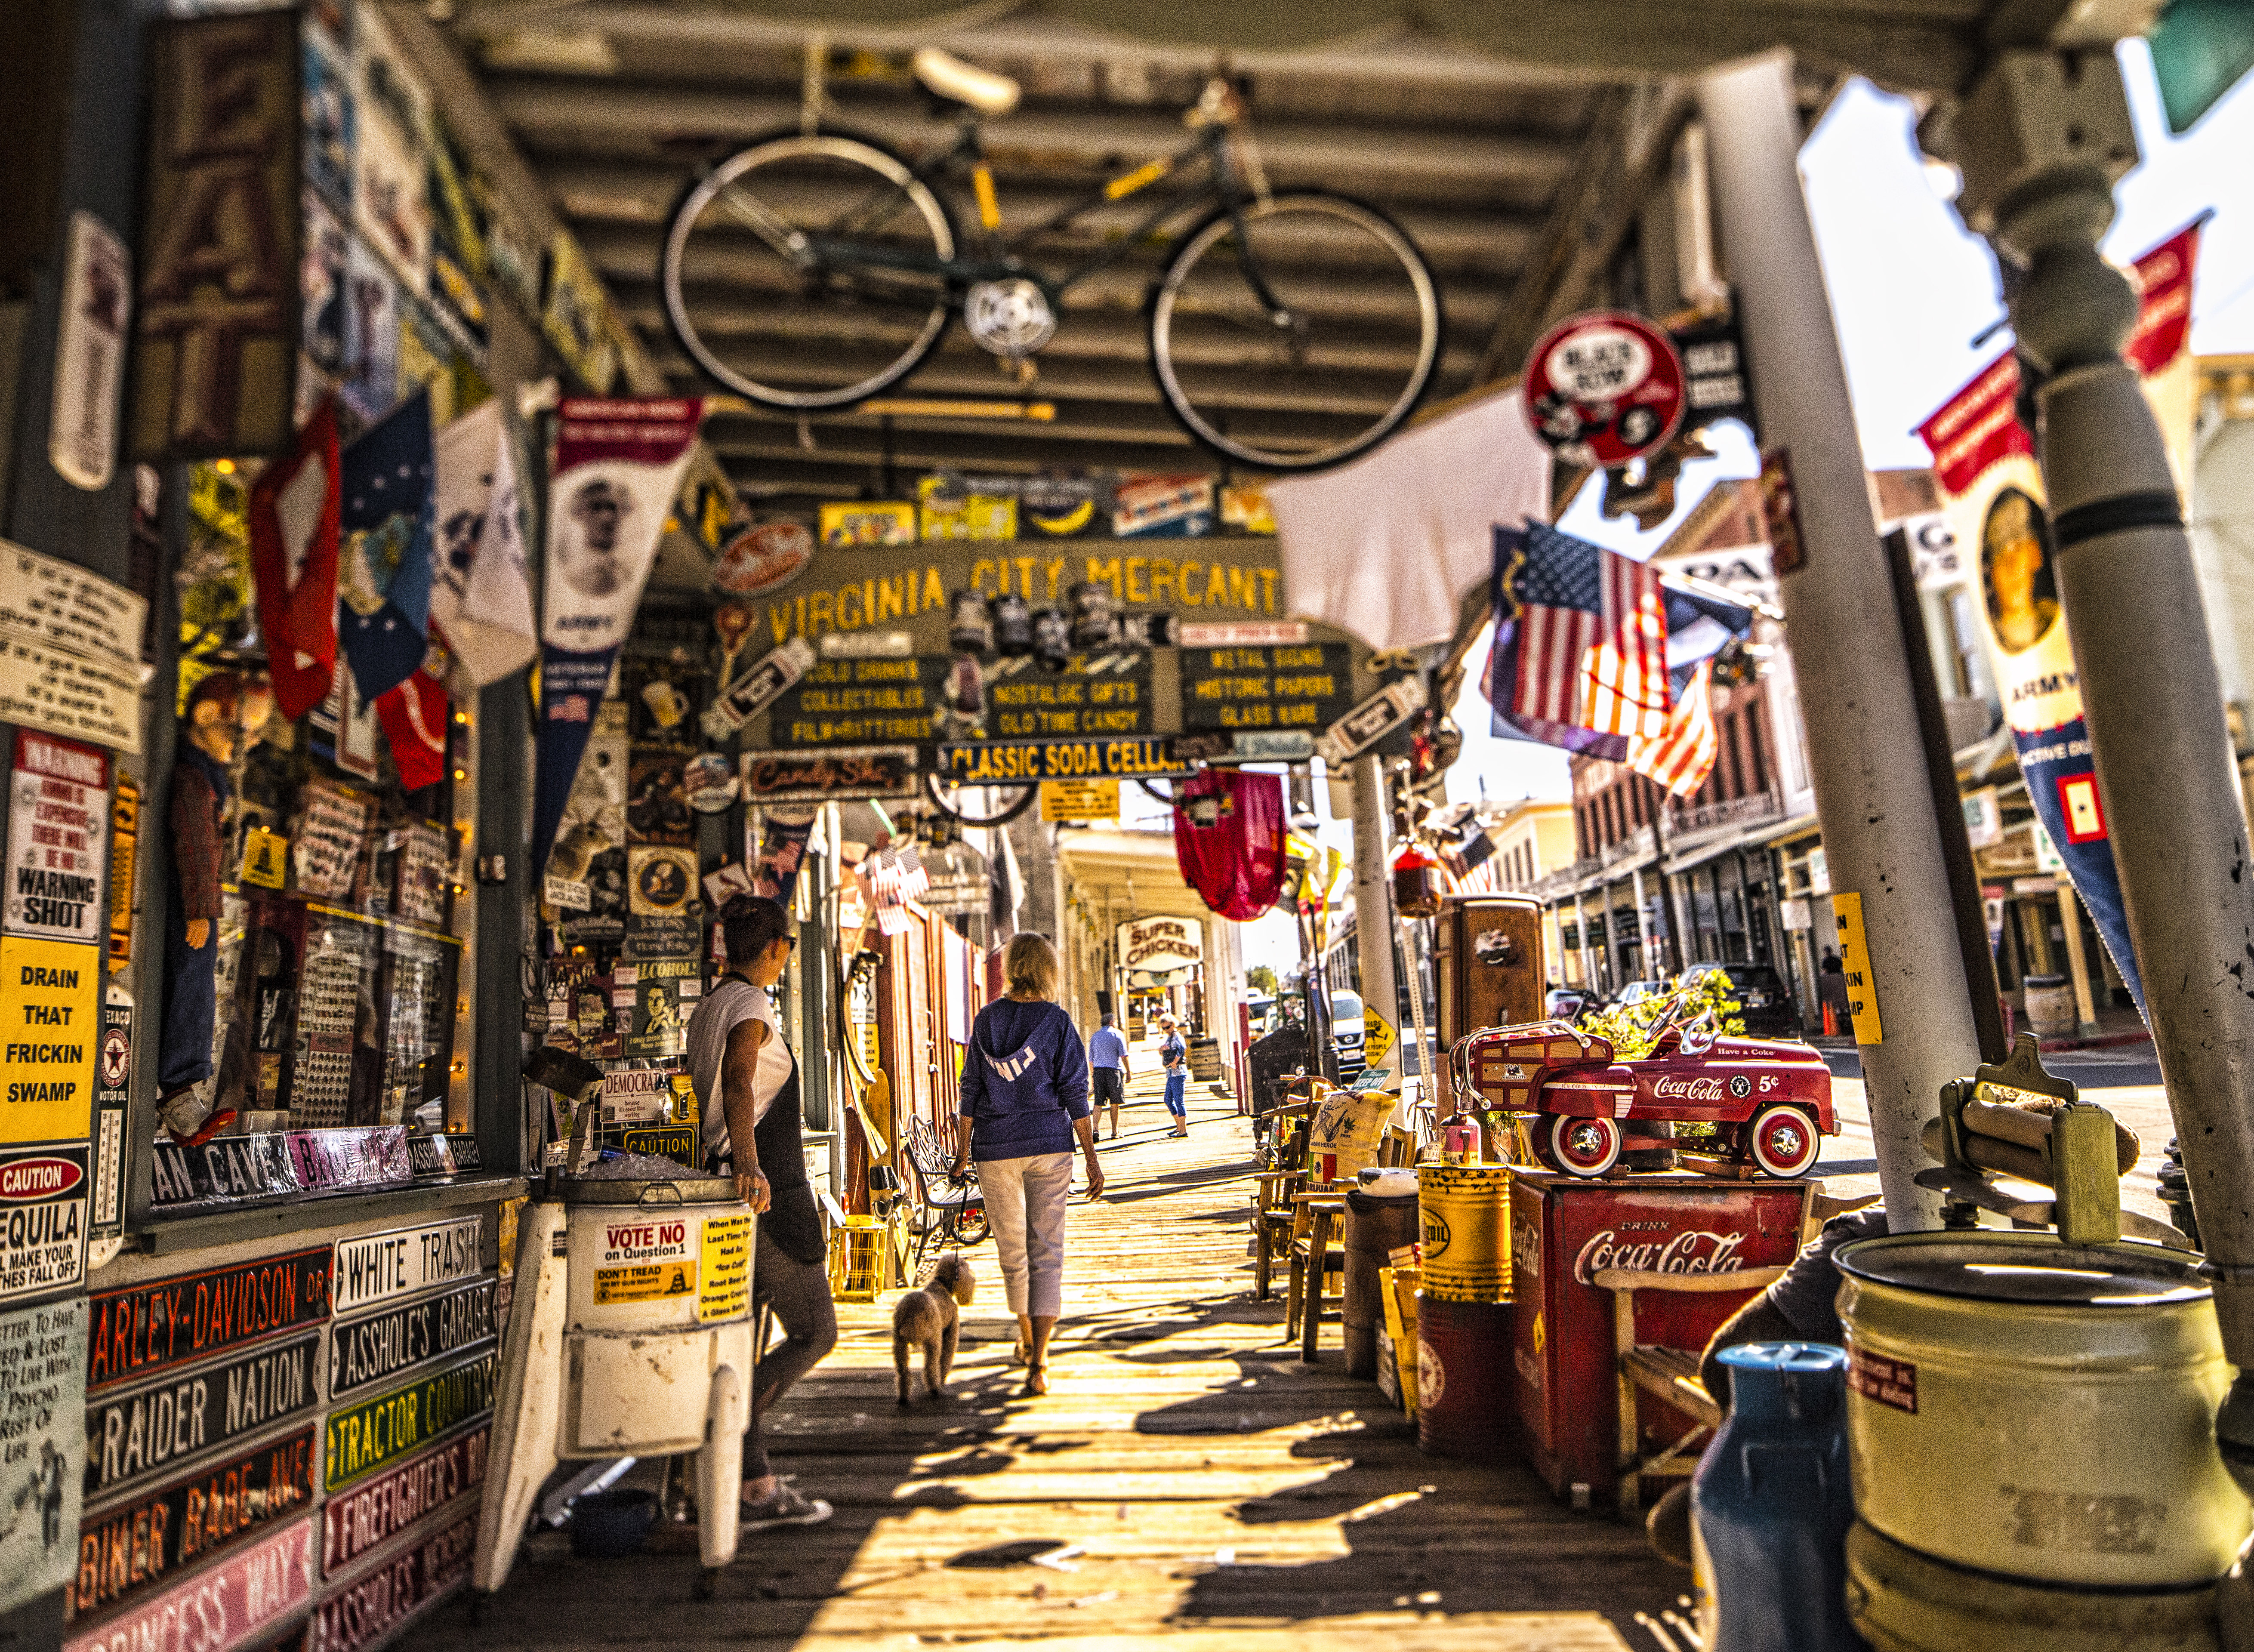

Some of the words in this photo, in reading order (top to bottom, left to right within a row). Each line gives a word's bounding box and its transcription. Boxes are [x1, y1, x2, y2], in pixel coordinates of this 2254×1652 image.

[769, 567, 944, 645] VIRGINIA
[971, 556, 1064, 600] CITY
[1087, 556, 1278, 613] MERCANT
[2010, 669, 2080, 702] ARMY
[2068, 740, 2092, 758] DU
[952, 746, 1039, 779] CLASSIC
[1045, 744, 1101, 775] SODA
[17, 867, 96, 904] WARNING
[22, 897, 86, 929] SHOT
[1130, 922, 1185, 945] SUPER
[1126, 939, 1199, 966] CHICKEN
[21, 965, 78, 989] DRAIN
[23, 1005, 73, 1026] THAT
[105, 1010, 130, 1026] EXACO
[5, 1043, 83, 1063] FRICKIN
[7, 1082, 77, 1103] SWAMP
[1653, 1076, 1725, 1100] Coca-Cola
[1758, 1074, 1779, 1093] 5¢
[118, 1091, 127, 1101] OIL
[453, 1140, 479, 1167] GARAGE
[629, 1137, 689, 1153] CAUTION
[3, 1165, 62, 1193] CAUTION
[151, 1147, 194, 1201] AN
[0, 1202, 78, 1249] EQUILA
[607, 1227, 654, 1249] VOTE
[659, 1224, 685, 1245] NO
[708, 1220, 729, 1229] When
[1620, 1221, 1670, 1230] DRINK
[707, 1234, 724, 1244] Last
[726, 1233, 741, 1242] Time
[9, 1249, 42, 1270] MAKE
[44, 1245, 73, 1263] YOUR
[348, 1238, 407, 1301] WHITE
[420, 1224, 482, 1282] TRASH
[605, 1251, 620, 1261] on
[623, 1245, 676, 1259] Question
[679, 1243, 685, 1254] 1
[720, 1247, 734, 1256] Had
[1574, 1230, 1748, 1285] Coca-Cola
[28, 1265, 54, 1285] FALL
[57, 1261, 77, 1278] OFF
[598, 1269, 628, 1280] DON'T
[631, 1266, 662, 1277] TREAD
[709, 1279, 727, 1288] Root
[0, 1319, 30, 1340] TTER
[88, 1263, 296, 1381] ARLEY-DAVIDSON
[307, 1269, 324, 1304] DR
[346, 1305, 430, 1386] ASSHOLE'S
[439, 1287, 489, 1349] GARAGE
[101, 1379, 207, 1483] RAIDER
[225, 1346, 305, 1435] NATION
[338, 1391, 418, 1477] TRACTOR
[77, 1502, 167, 1610] BIKER
[184, 1462, 253, 1556] BABE
[91, 1575, 228, 1652] INCESS
